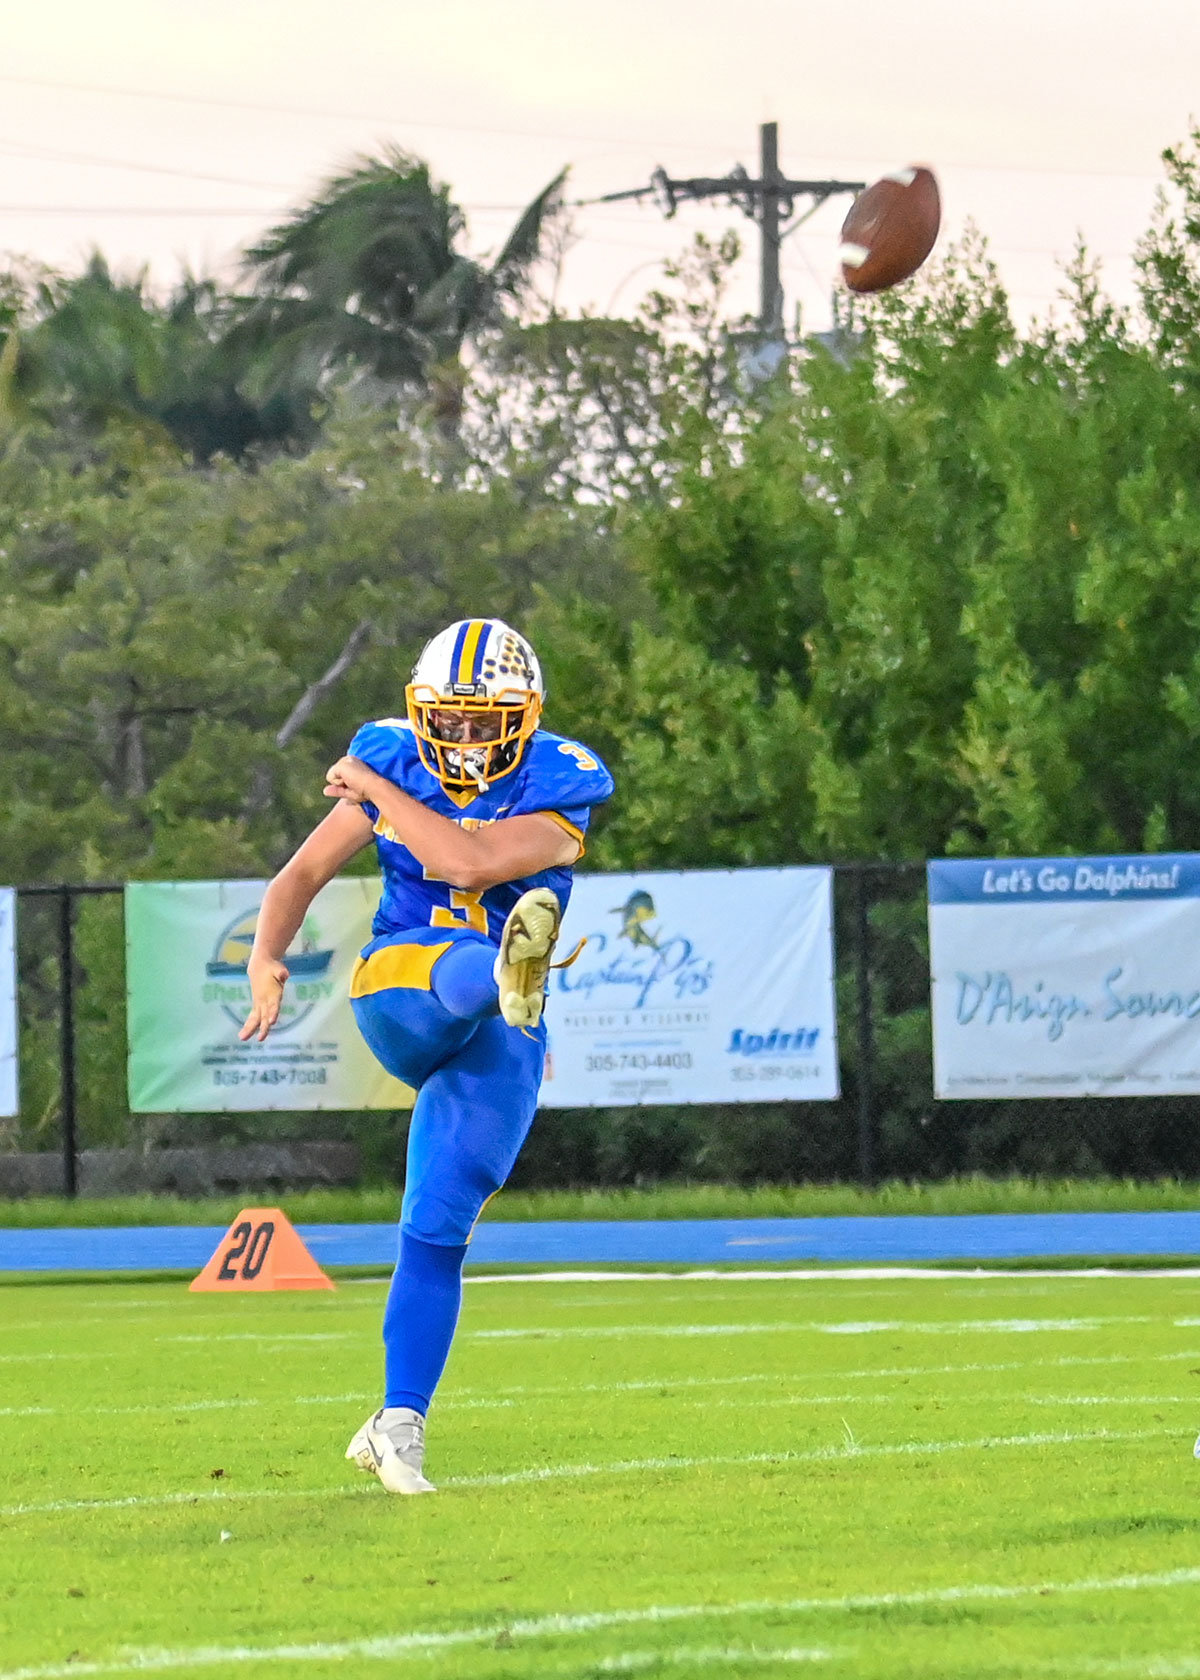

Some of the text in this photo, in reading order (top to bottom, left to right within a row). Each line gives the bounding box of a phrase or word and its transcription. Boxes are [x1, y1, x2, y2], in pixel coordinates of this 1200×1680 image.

[557, 743, 598, 771] 3
[982, 864, 1180, 896] Let's Go Dolphins!
[585, 1052, 693, 1072] 305-743-4403
[217, 1221, 275, 1281] 20
